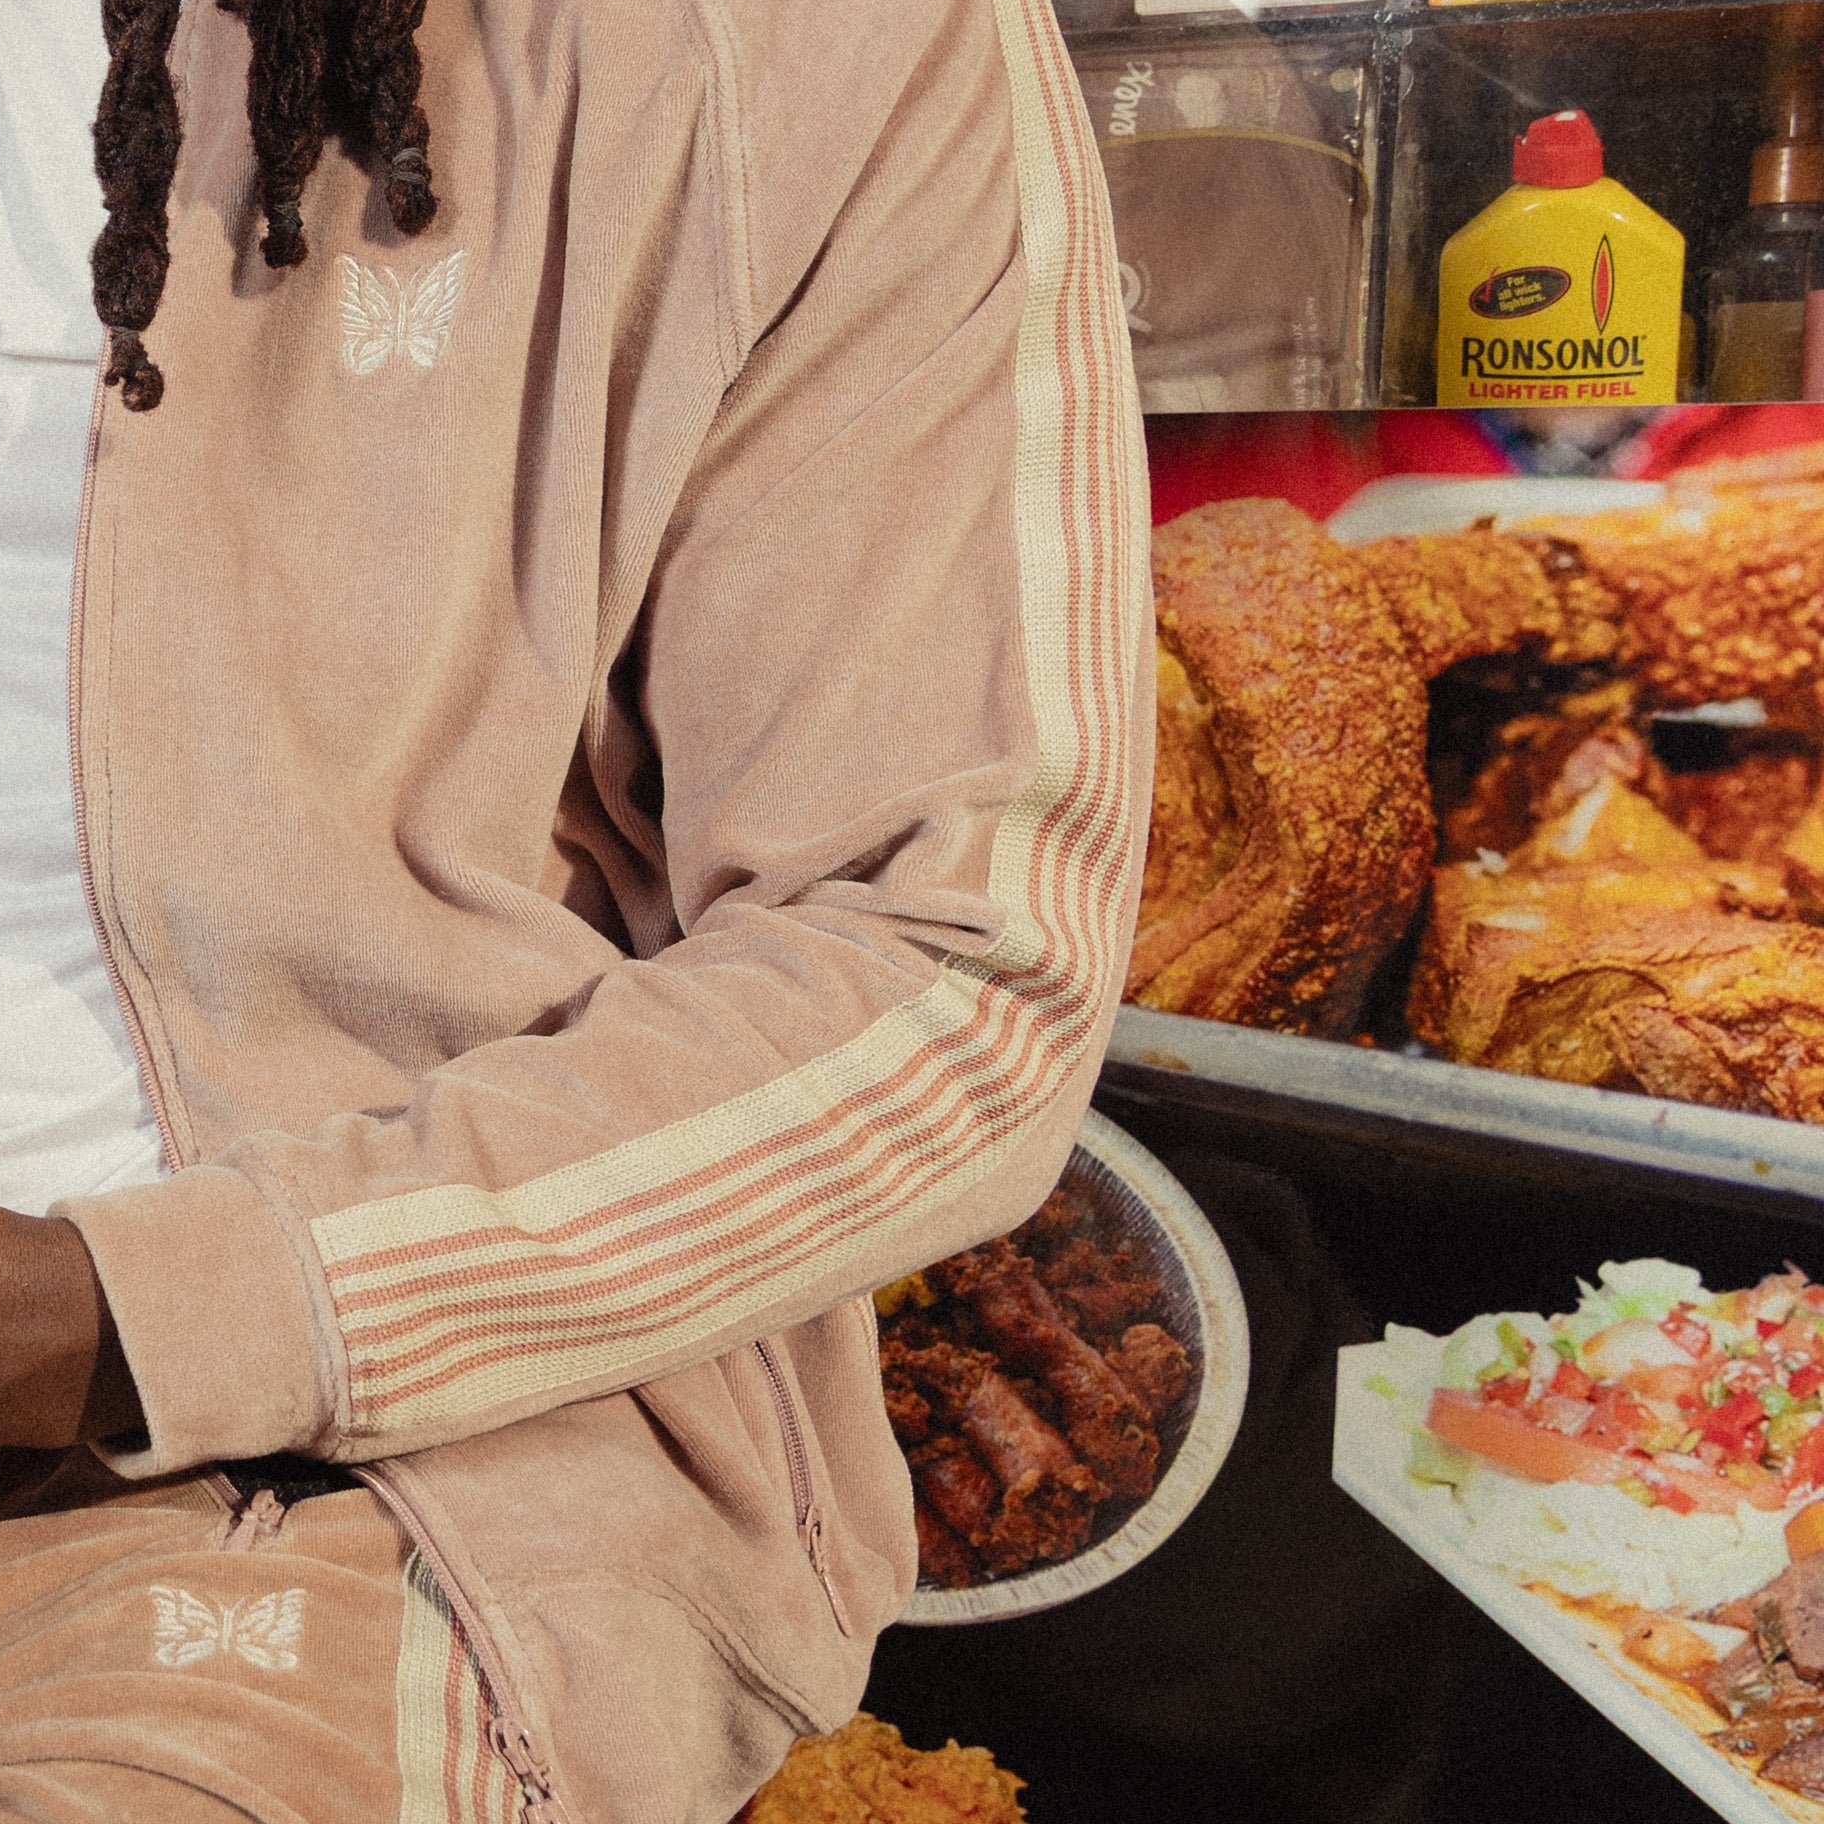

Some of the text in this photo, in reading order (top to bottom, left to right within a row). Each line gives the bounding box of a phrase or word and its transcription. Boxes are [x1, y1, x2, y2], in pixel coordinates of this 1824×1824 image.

[1496, 280, 1543, 303] all wick
[1506, 275, 1527, 288] For
[1498, 293, 1547, 315] lighters.
[1461, 336, 1644, 379] RONSONOL
[1467, 380, 1638, 401] LIGHTER FUEL
